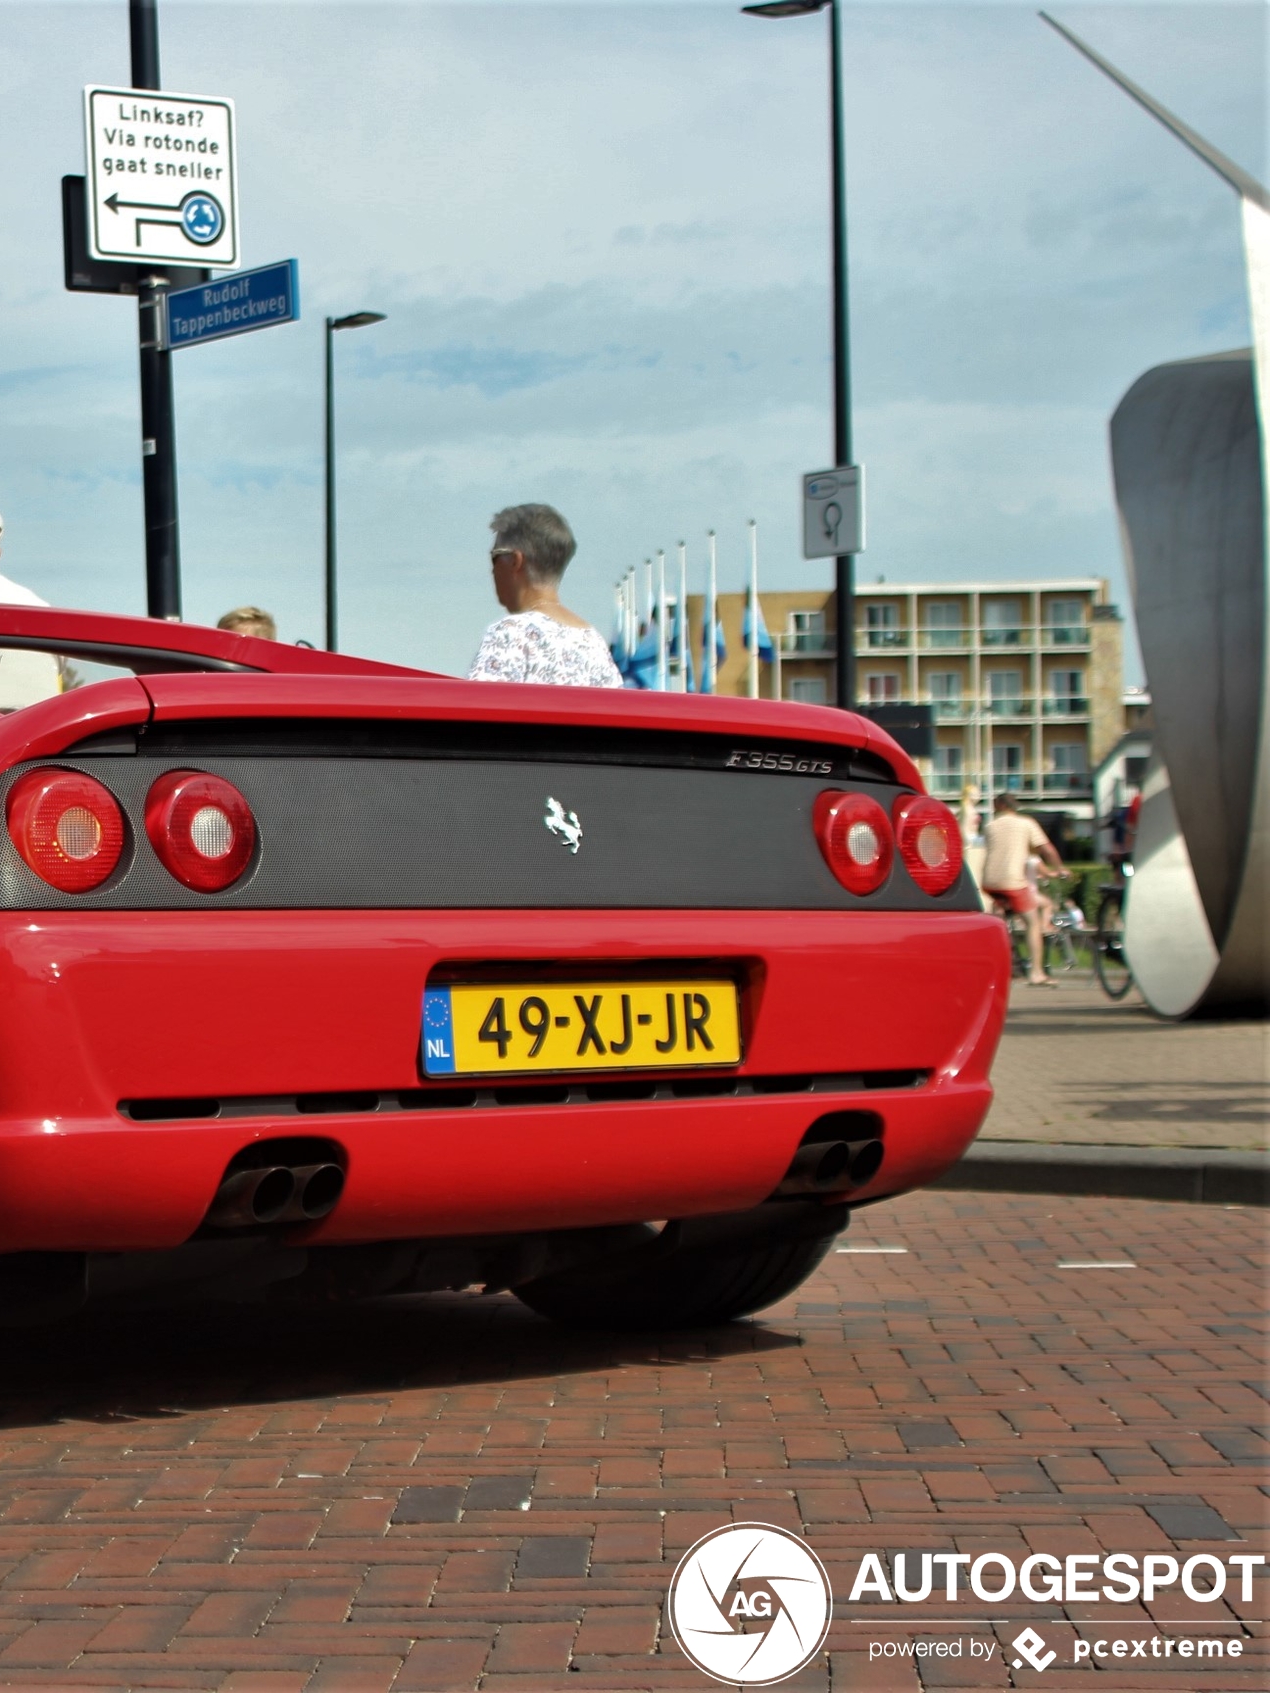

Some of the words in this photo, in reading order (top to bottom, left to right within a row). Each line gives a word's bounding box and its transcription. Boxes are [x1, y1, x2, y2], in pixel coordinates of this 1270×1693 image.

[119, 103, 204, 128] Linksaf?
[104, 128, 135, 147] Via
[144, 133, 219, 154] rotonde
[103, 157, 147, 175] gaat
[154, 160, 223, 180] sneller
[203, 279, 251, 308] Rudolf
[173, 295, 286, 336] Tappenbeckweg
[478, 993, 716, 1060] 49-XJ-JR
[427, 1040, 450, 1058] NL
